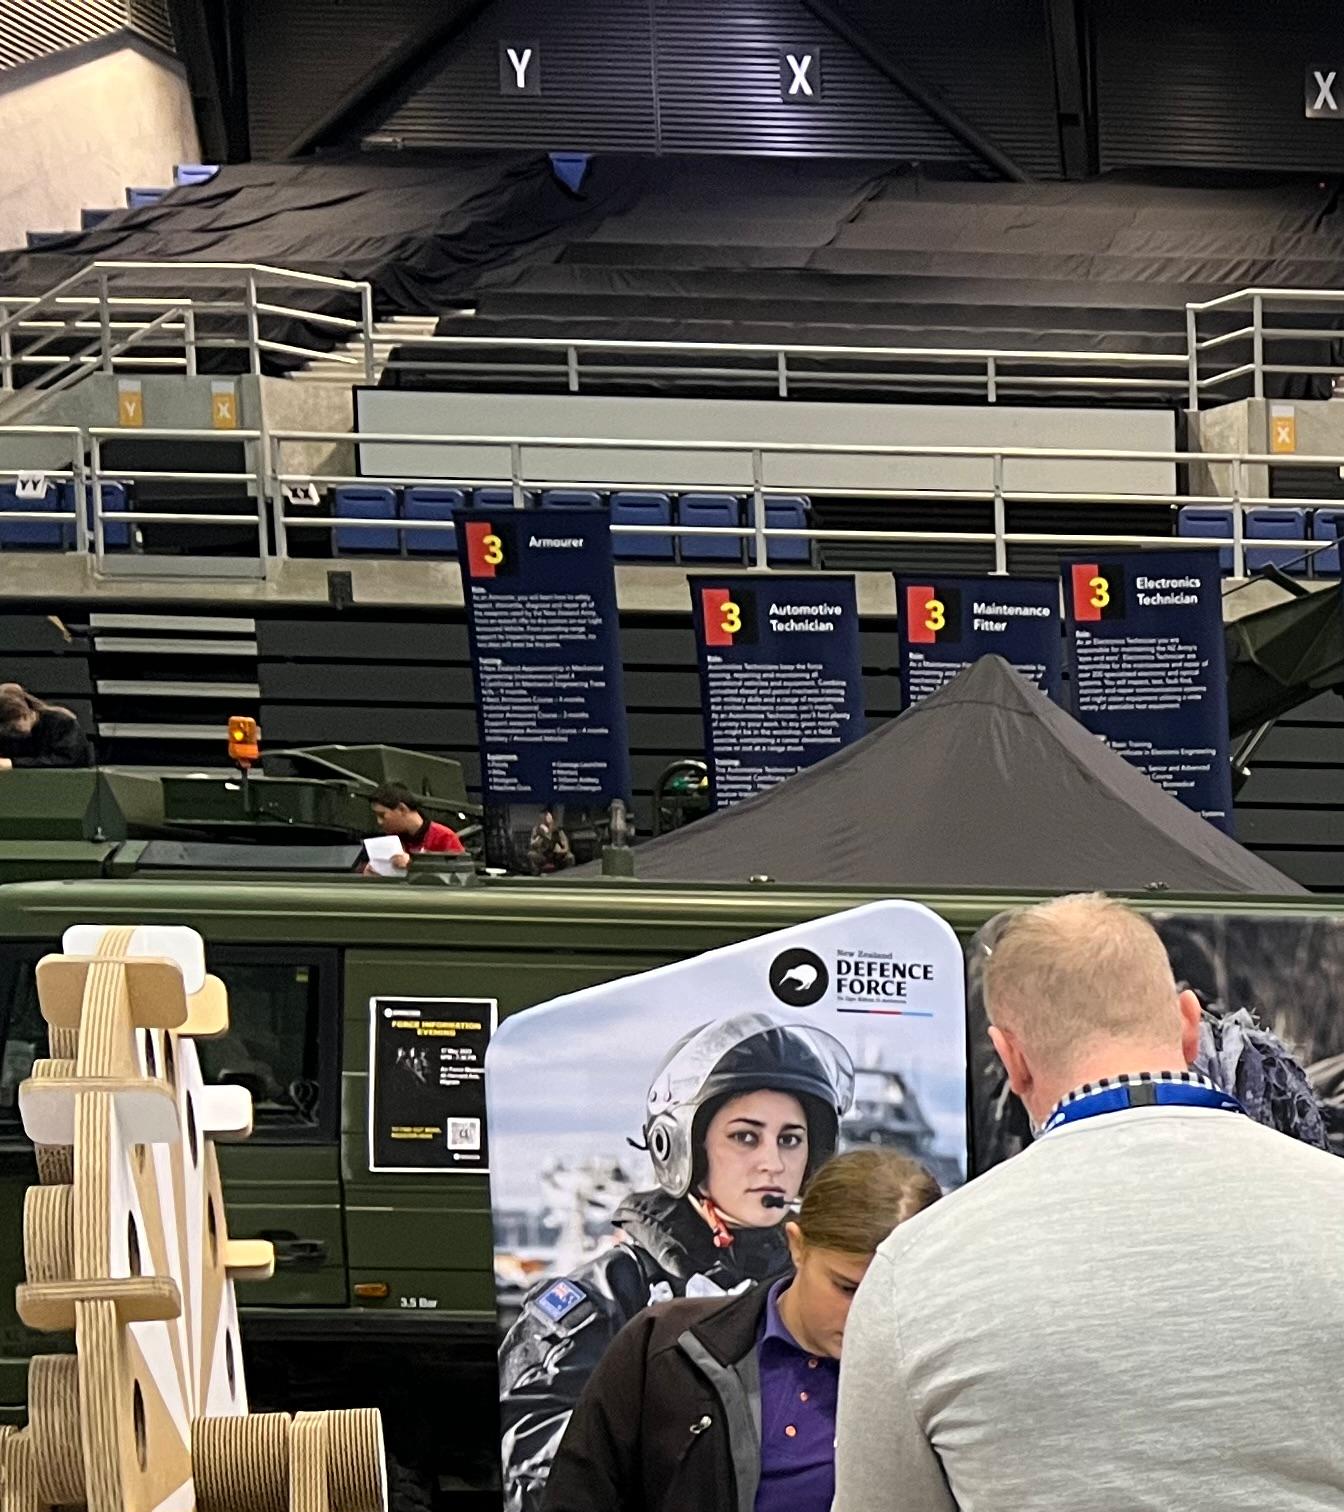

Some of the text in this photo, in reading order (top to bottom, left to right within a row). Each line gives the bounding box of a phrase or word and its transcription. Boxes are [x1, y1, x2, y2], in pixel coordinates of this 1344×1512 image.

[506, 49, 532, 88] Y
[786, 55, 813, 96] X
[1312, 72, 1338, 112] X
[124, 401, 136, 417] Y
[218, 403, 230, 419] X
[1277, 427, 1290, 443] X
[529, 536, 584, 548] Armourer
[483, 535, 503, 566] 3
[1136, 577, 1201, 590] Electronics
[1089, 577, 1110, 608] 3
[1137, 592, 1199, 606] Technician
[720, 602, 742, 633] 3
[769, 603, 842, 617] Automotive
[925, 600, 945, 631] 3
[973, 602, 1050, 618] Maintenance
[770, 619, 834, 632] Technician
[973, 618, 1008, 632] Fitter
[857, 950, 893, 960] Zealand
[836, 959, 934, 981] DEFENCE
[836, 978, 907, 997] FORCE
[400, 1296, 438, 1308] 3.5 Bar
